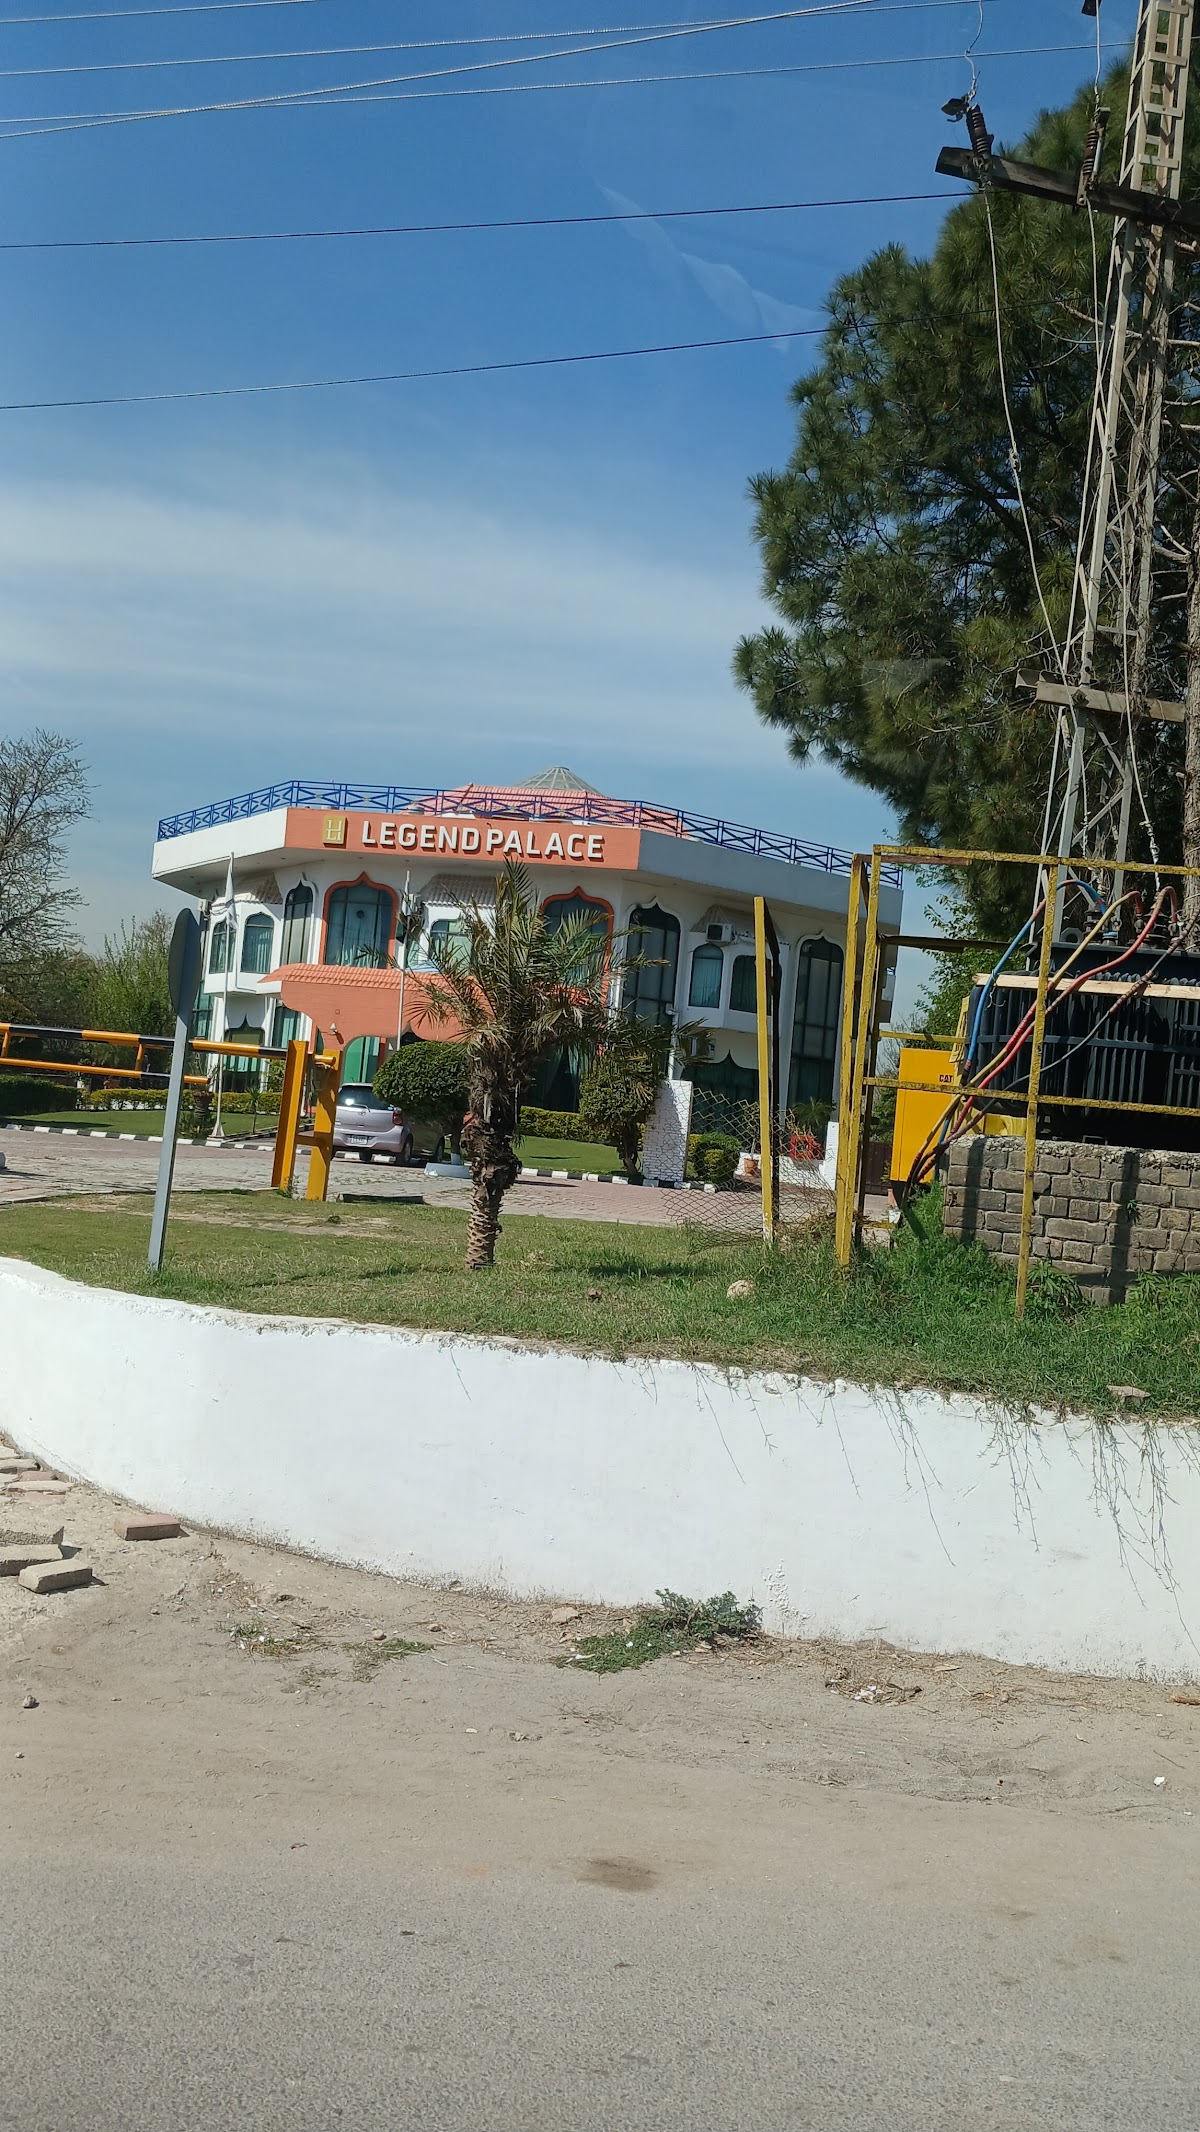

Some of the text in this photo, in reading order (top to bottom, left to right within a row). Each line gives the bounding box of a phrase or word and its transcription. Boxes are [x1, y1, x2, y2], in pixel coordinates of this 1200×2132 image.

[362, 820, 604, 858] LEGEND PALACE
[939, 1074, 953, 1083] CAT
